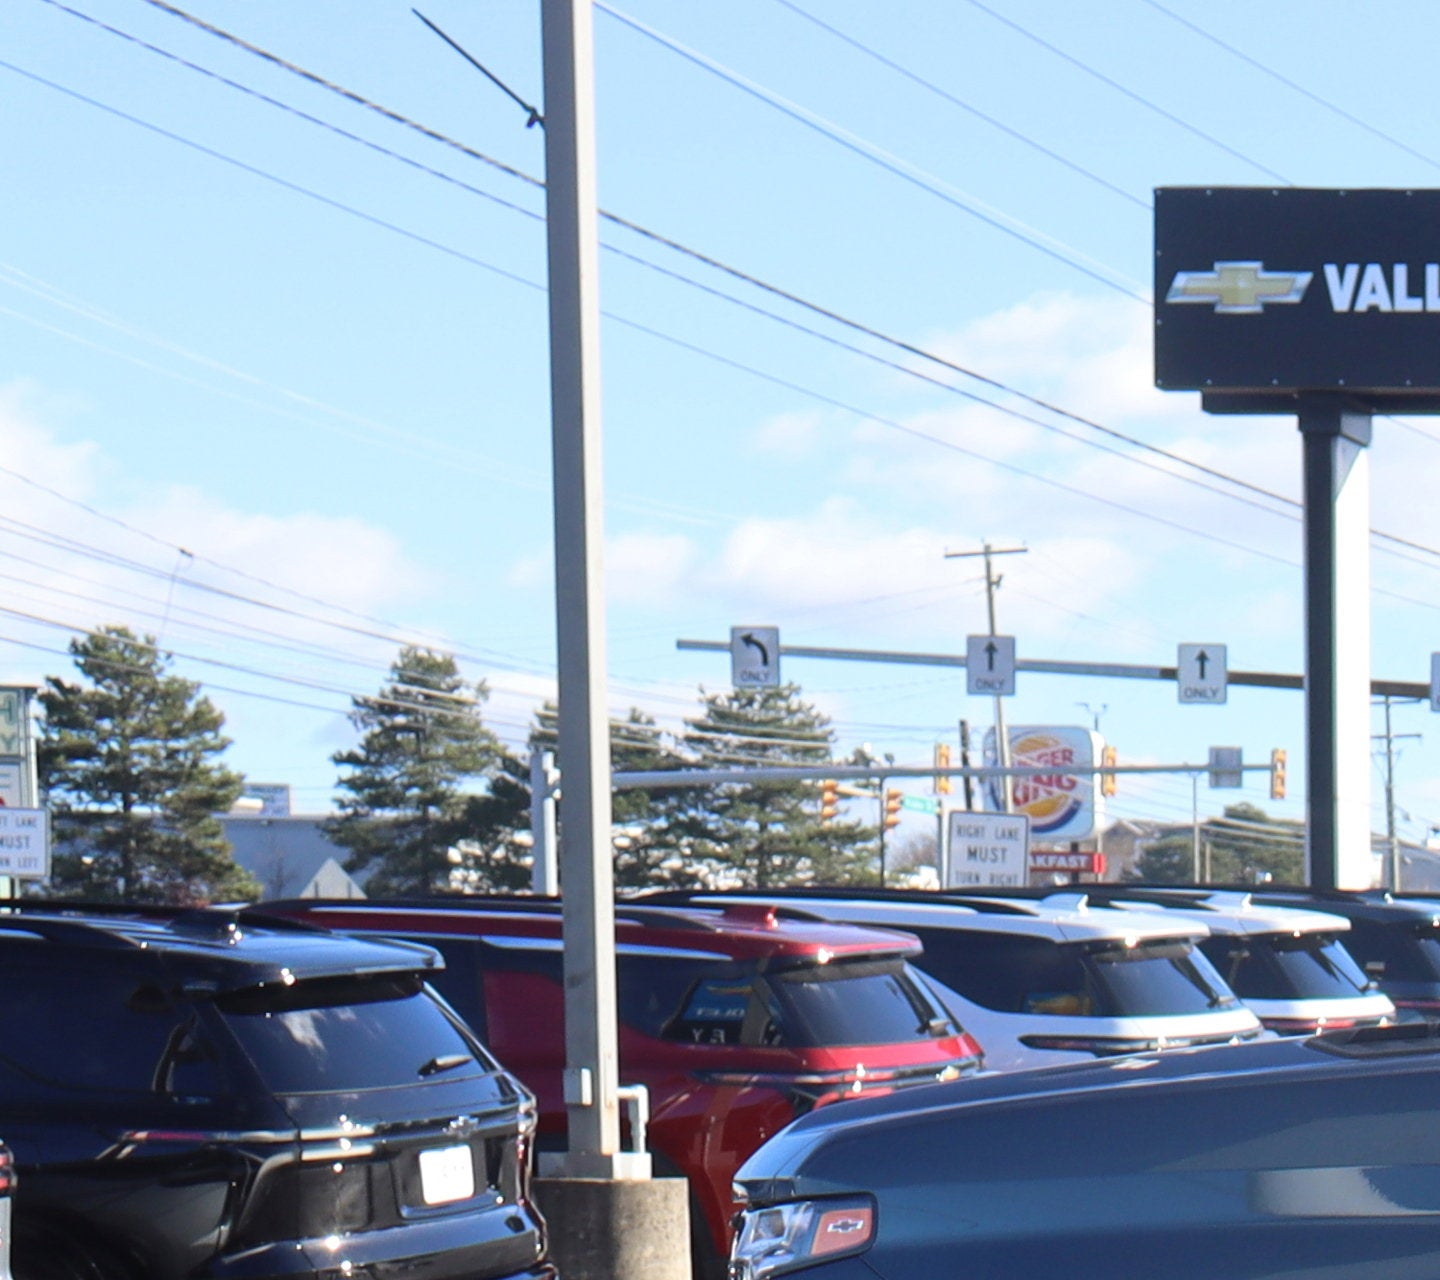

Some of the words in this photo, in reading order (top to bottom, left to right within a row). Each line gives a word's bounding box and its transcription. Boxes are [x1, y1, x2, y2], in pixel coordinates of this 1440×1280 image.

[740, 671, 770, 682] ONLY
[975, 678, 1004, 690] ONLY
[1183, 688, 1219, 699] ONLY
[956, 824, 985, 838] RIGHT
[995, 827, 1019, 840] LANE
[967, 846, 1007, 863] MUST
